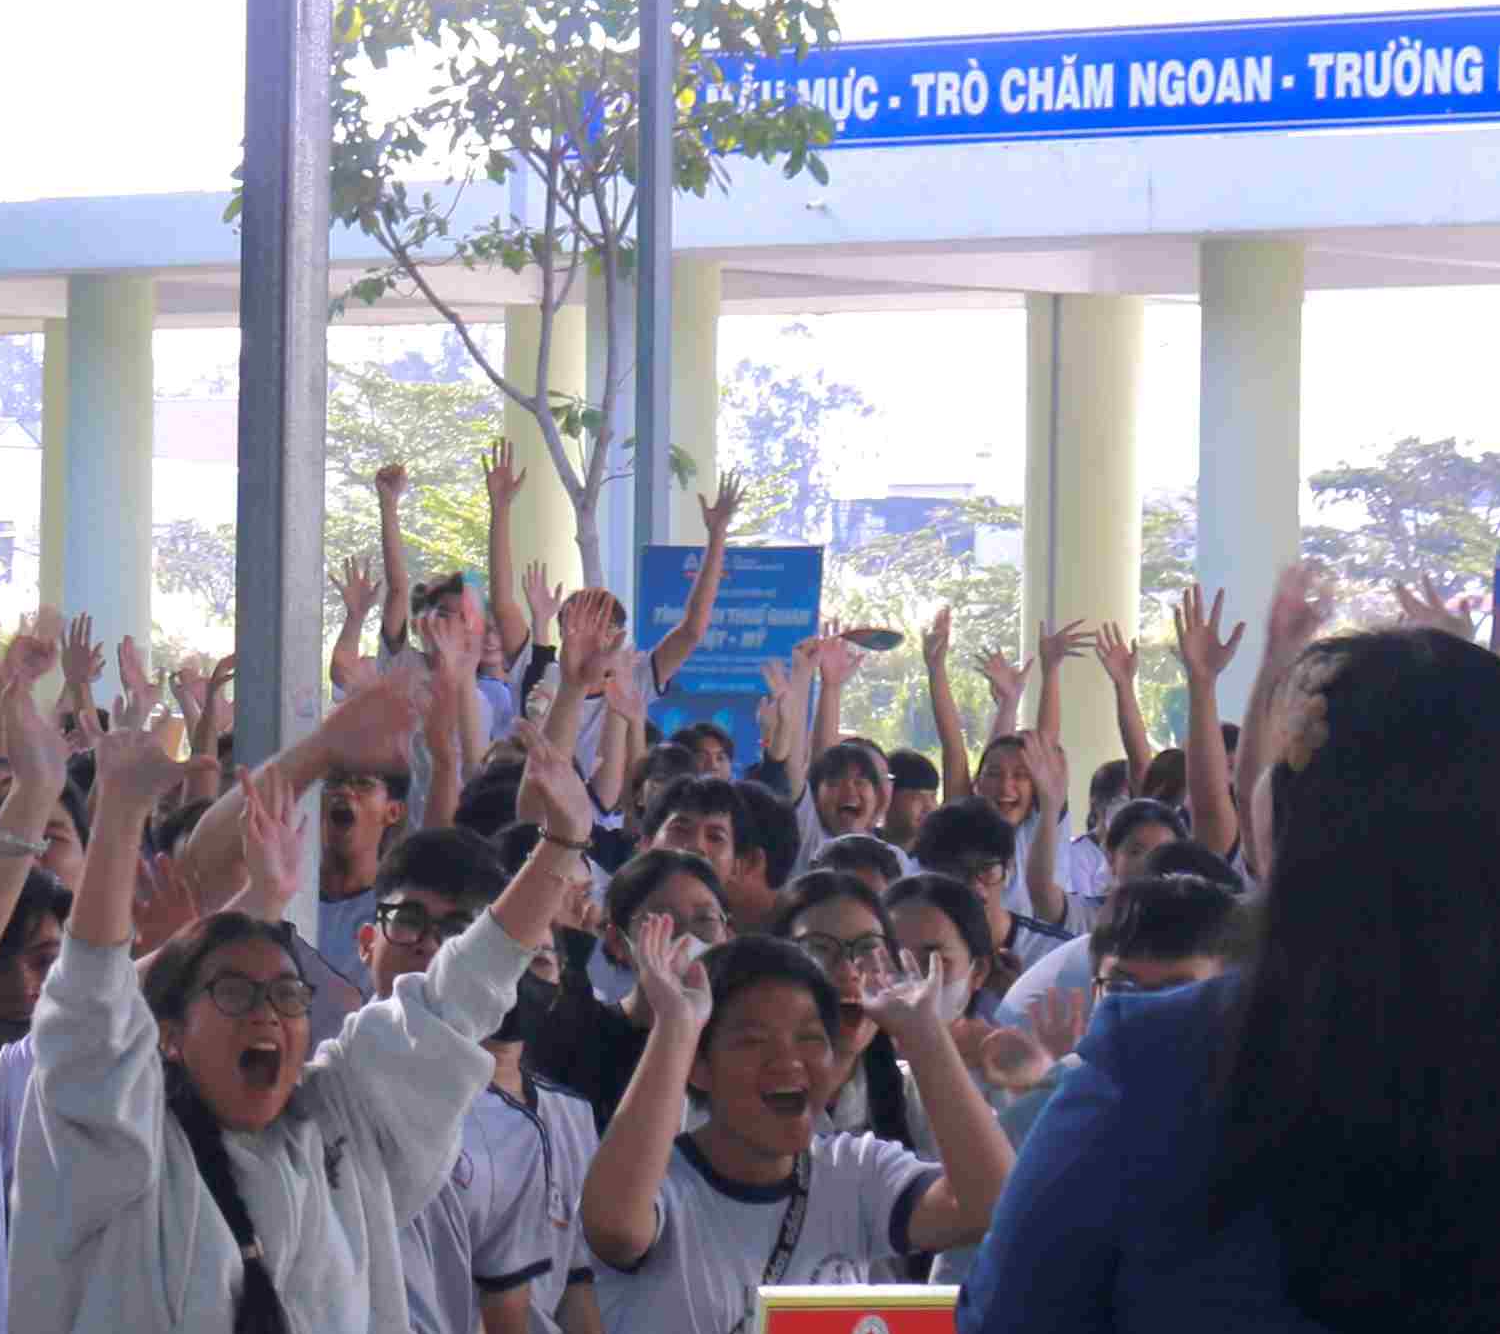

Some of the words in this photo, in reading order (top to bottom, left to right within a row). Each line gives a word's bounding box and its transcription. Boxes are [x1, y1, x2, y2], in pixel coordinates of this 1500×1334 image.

[797, 67, 879, 132] MỰC
[911, 58, 988, 118] TRÒ
[1000, 54, 1114, 115] CHĂM
[1128, 55, 1273, 108] NGOAN
[1307, 36, 1485, 100] TRƯỜNG
